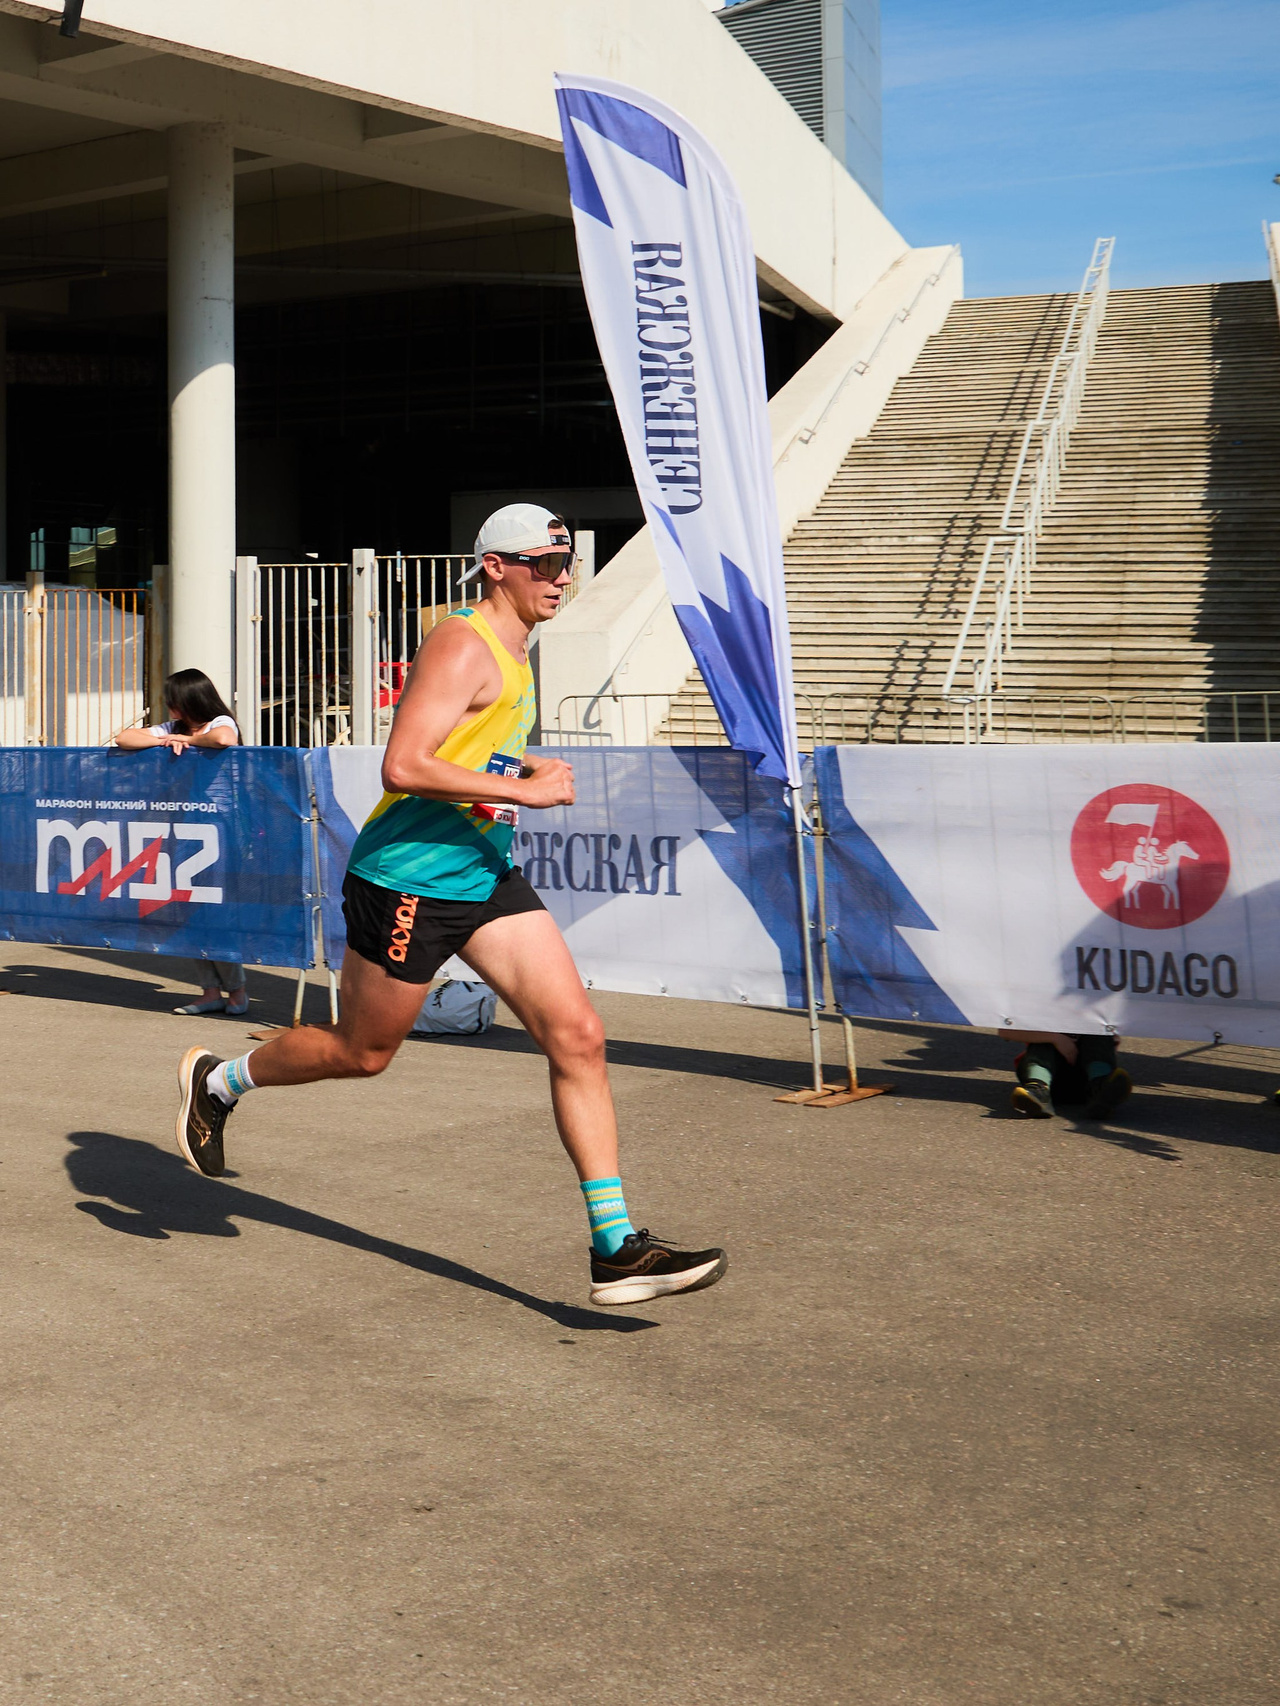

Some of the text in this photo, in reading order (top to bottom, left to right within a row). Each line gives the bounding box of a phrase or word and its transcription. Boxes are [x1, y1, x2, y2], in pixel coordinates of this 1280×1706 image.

[35, 798, 218, 813] МАРАФОН НИЖНИЙ НОВГОРОД
[513, 831, 682, 896] ЖСКАЯ
[1075, 945, 1239, 999] KUDAGO
